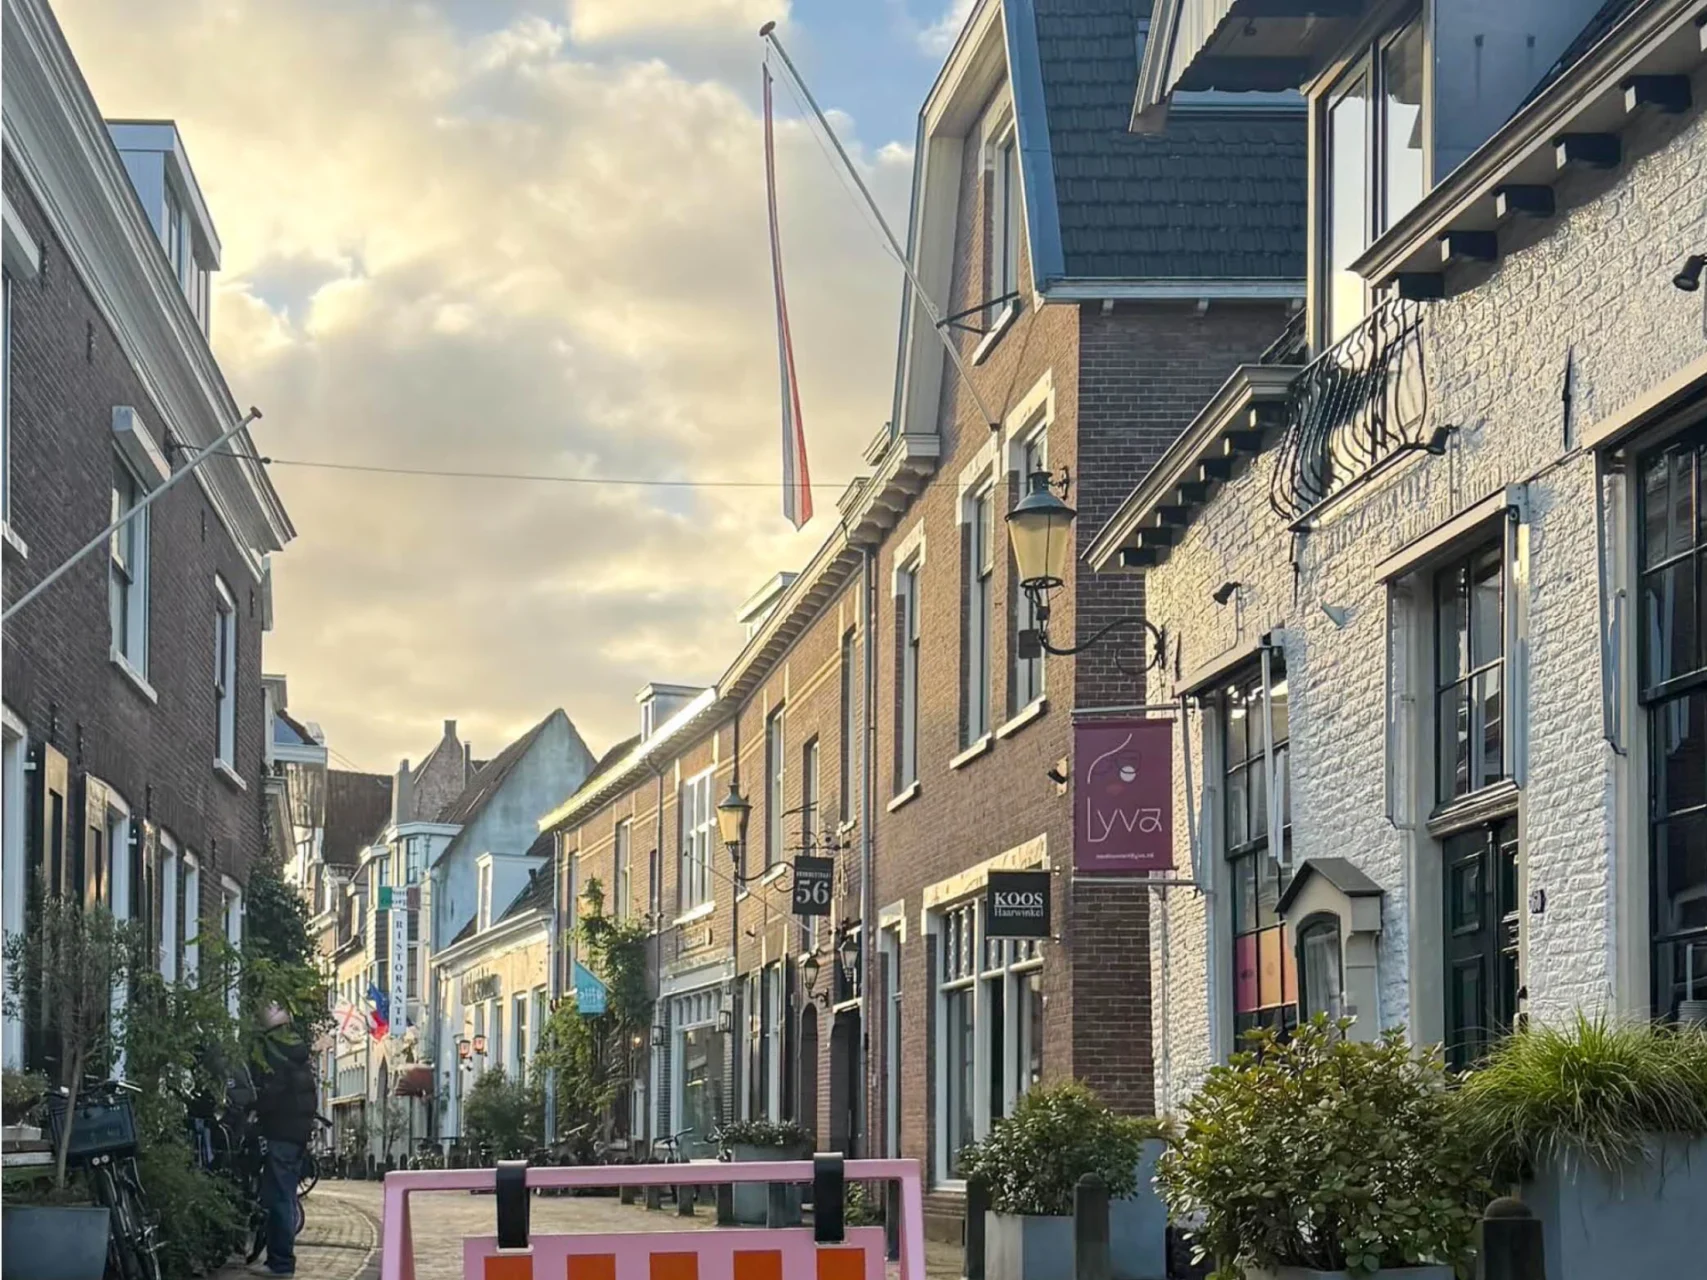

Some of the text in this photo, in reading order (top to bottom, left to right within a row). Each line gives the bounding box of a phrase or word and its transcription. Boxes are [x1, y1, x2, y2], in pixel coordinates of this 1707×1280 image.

[1087, 797, 1163, 842] Lyva
[796, 880, 829, 904] 56
[994, 892, 1043, 906] KOOS
[994, 907, 1044, 917] Haarwinkel
[395, 920, 404, 1026] RISTORANTE
